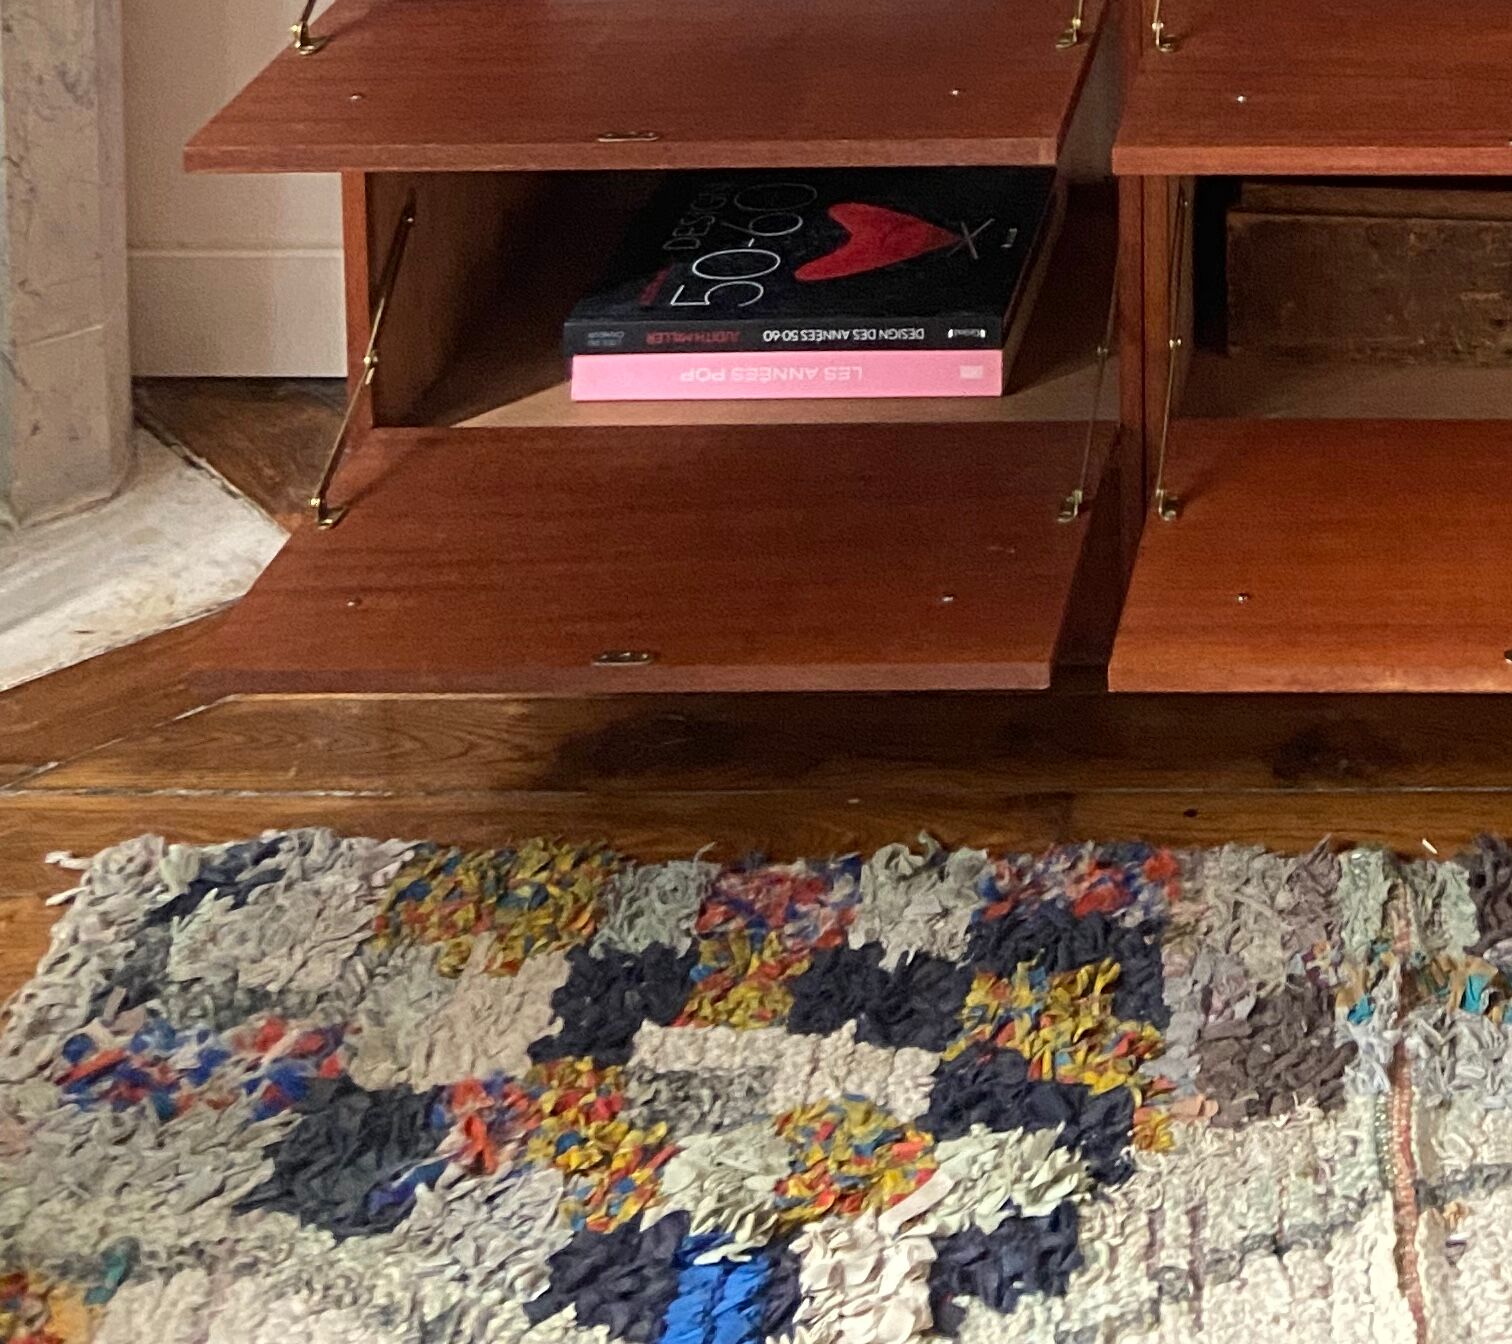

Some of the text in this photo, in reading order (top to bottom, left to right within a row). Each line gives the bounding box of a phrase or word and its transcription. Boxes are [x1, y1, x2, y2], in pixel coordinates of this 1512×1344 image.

[800, 328, 851, 342] ANNÉES
[853, 328, 877, 340] DES
[878, 328, 925, 340] DESIGN
[679, 365, 863, 385] LES ANNÉES POP
